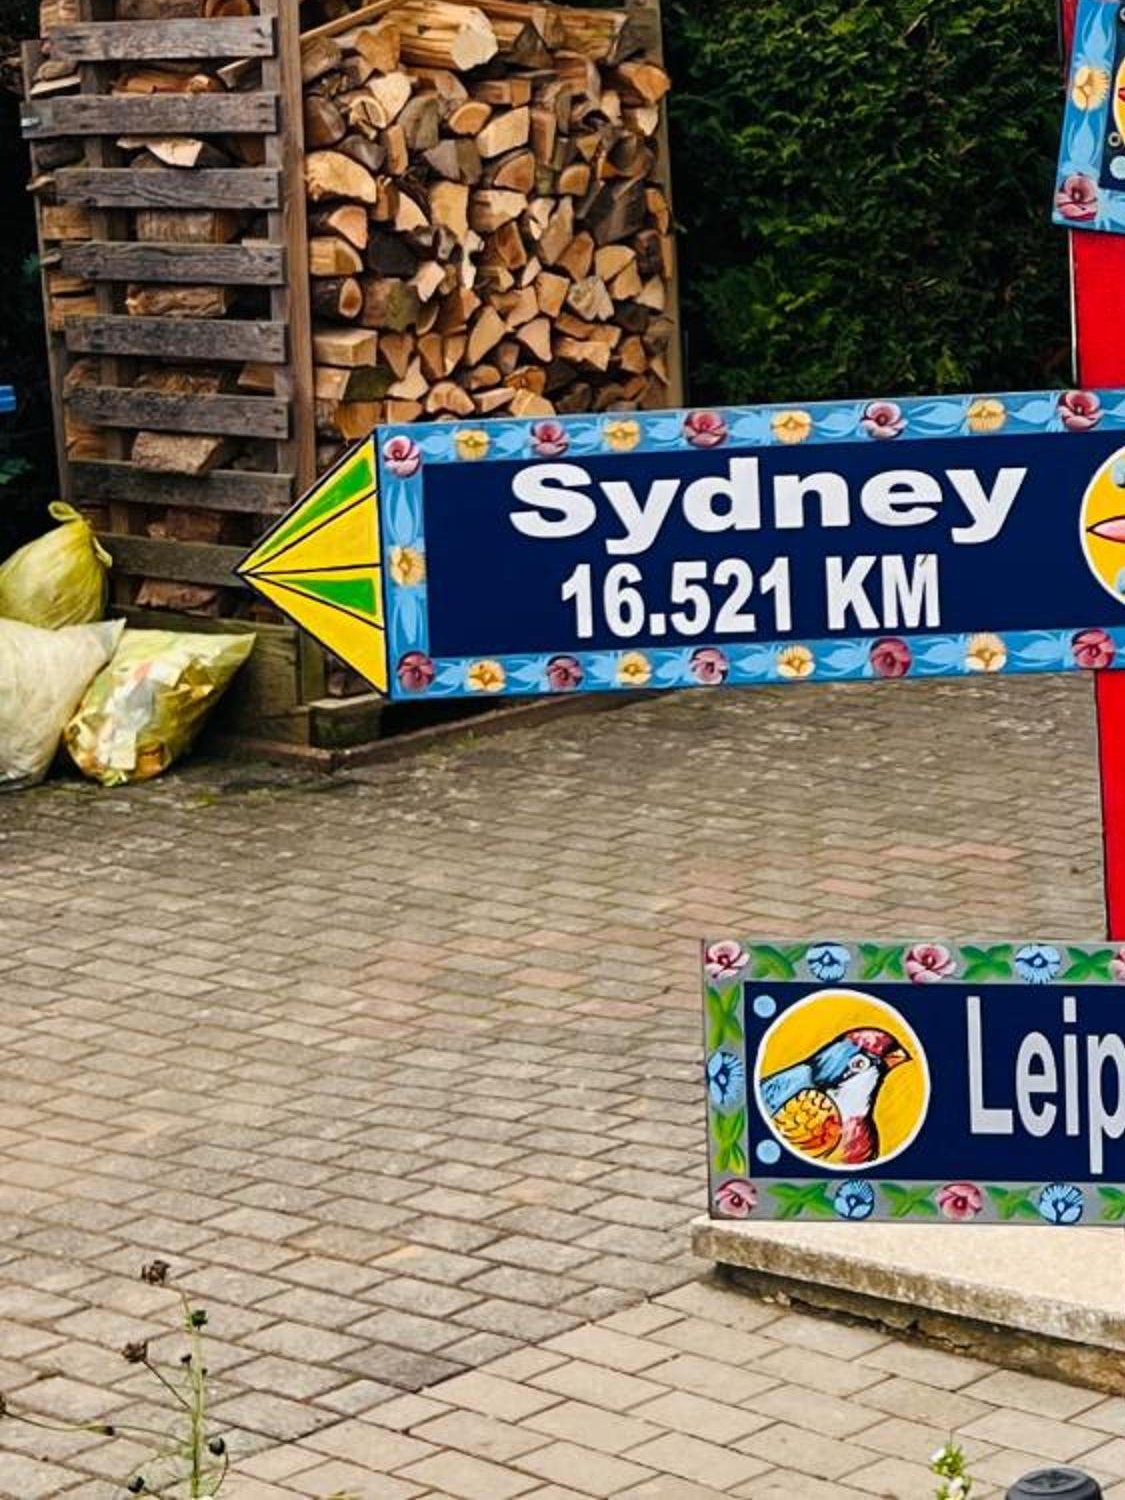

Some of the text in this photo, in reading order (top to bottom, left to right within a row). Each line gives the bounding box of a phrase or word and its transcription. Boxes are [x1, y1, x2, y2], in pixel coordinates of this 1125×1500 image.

[510, 457, 1027, 555] Sydney
[562, 554, 940, 638] 16.521 KM
